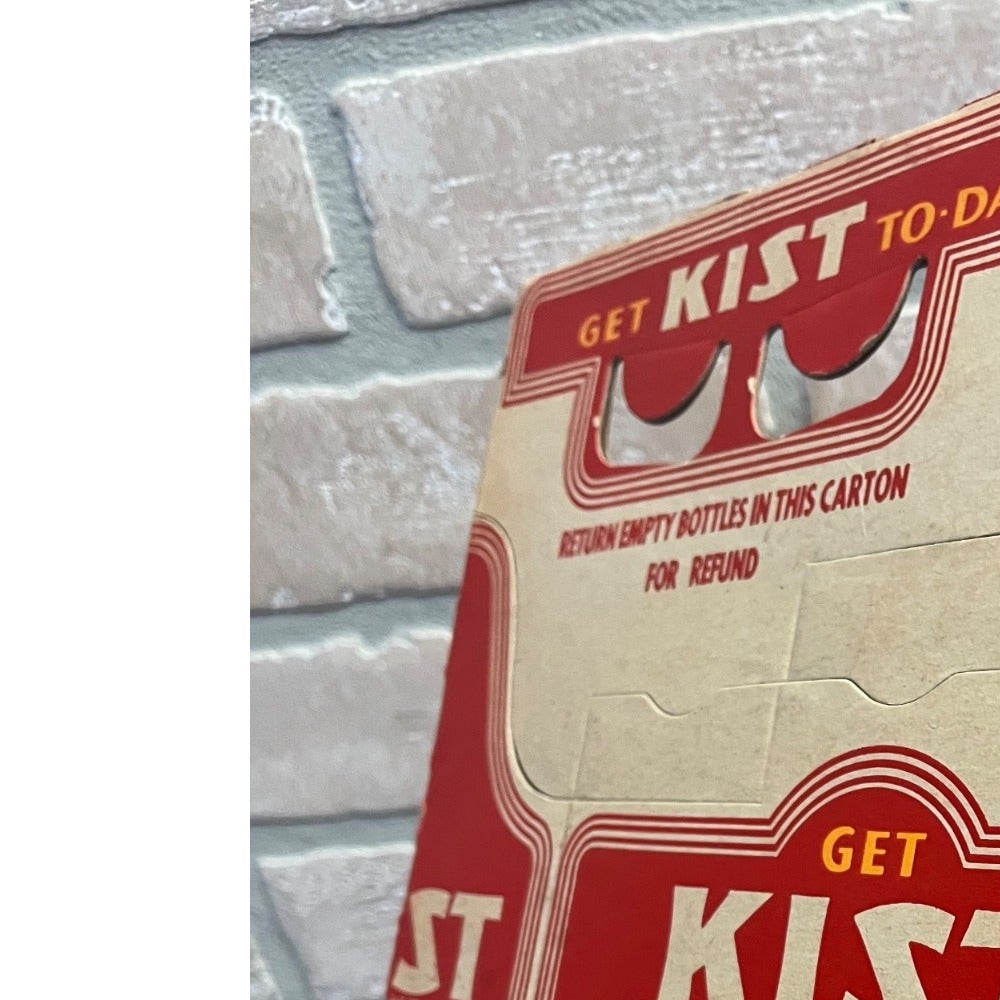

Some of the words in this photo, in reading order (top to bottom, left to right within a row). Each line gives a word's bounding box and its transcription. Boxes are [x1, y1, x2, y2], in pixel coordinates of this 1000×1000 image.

[578, 299, 650, 348] GET
[660, 202, 868, 332] KIST
[558, 522, 619, 559] RETURN
[618, 512, 677, 549] EMPTY
[676, 497, 749, 539] BOTTLES
[750, 493, 770, 526] IN
[774, 483, 818, 521] THIS
[820, 463, 911, 512] CARTON
[645, 559, 680, 592] FOR
[688, 546, 760, 587] REFUND
[821, 826, 927, 877] GET
